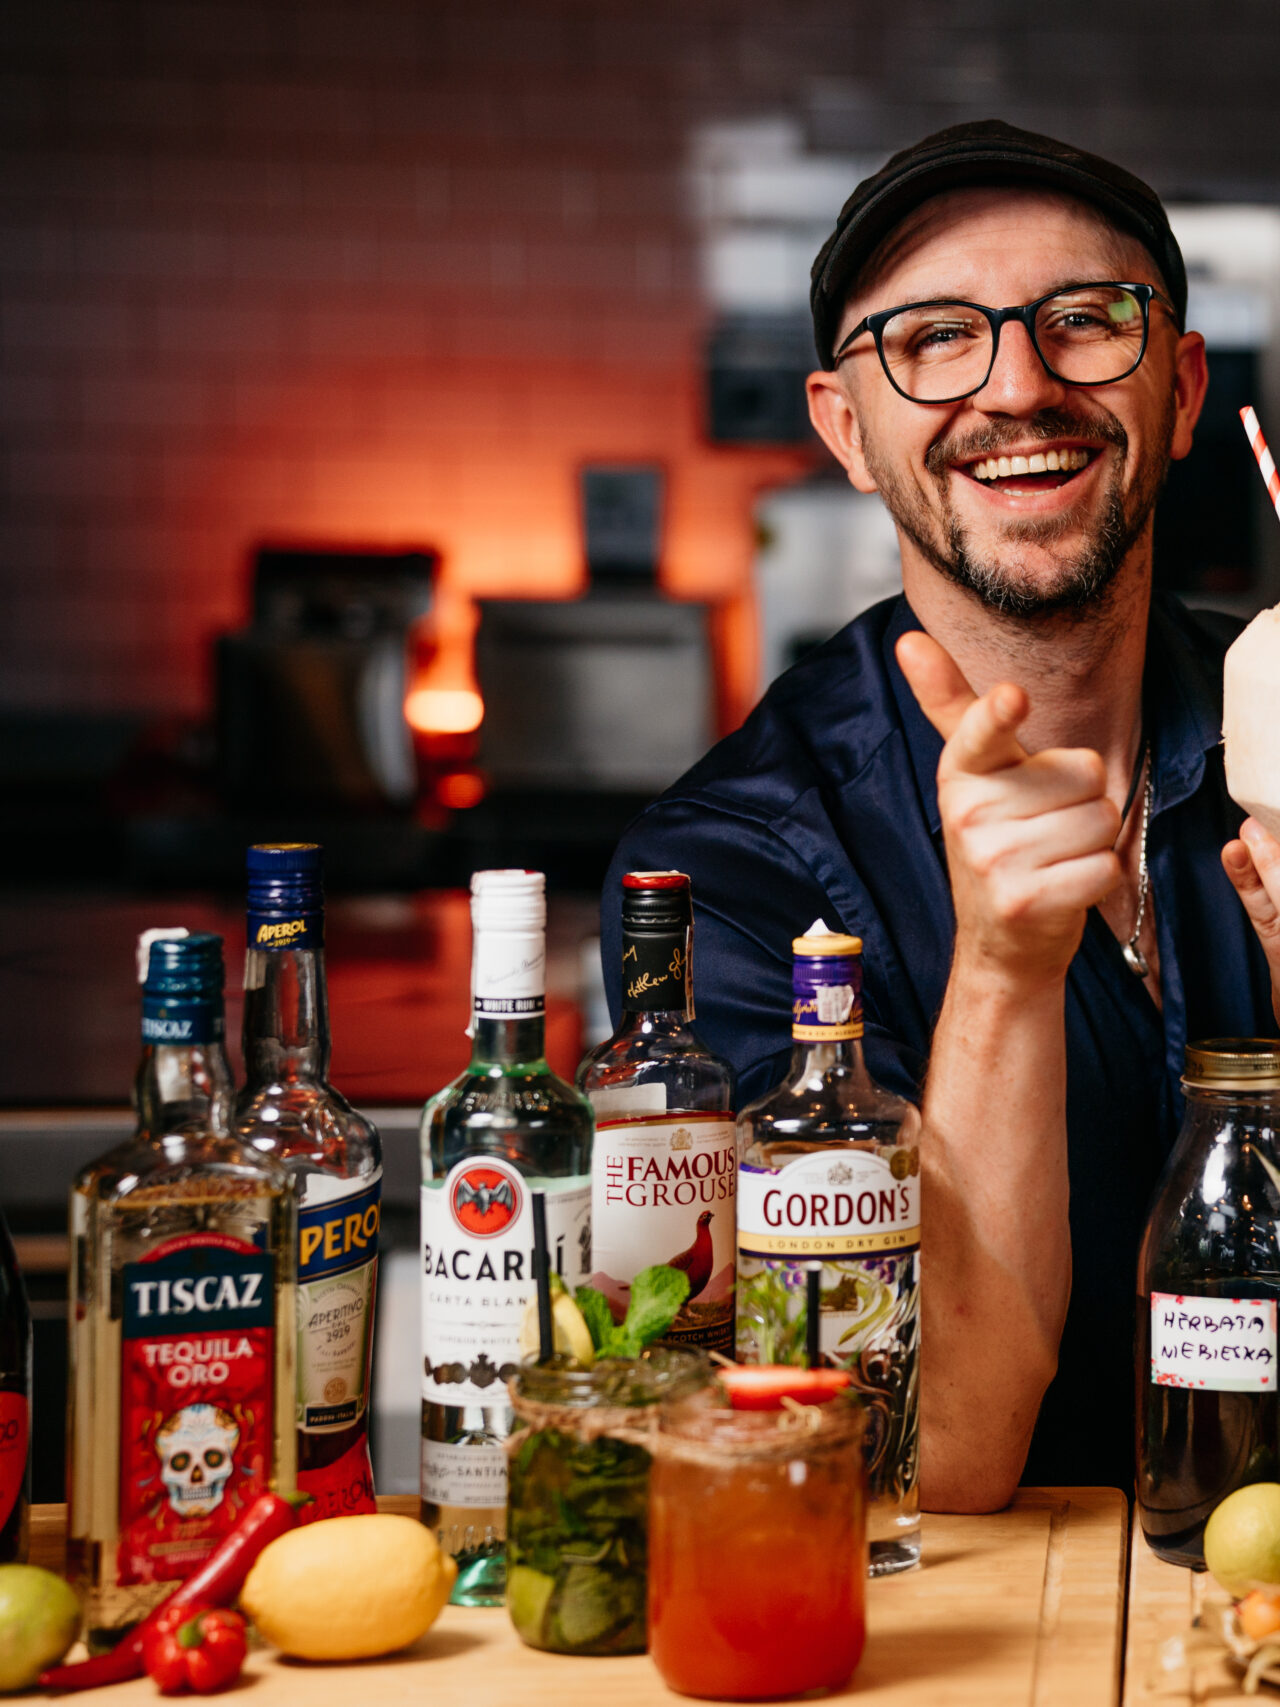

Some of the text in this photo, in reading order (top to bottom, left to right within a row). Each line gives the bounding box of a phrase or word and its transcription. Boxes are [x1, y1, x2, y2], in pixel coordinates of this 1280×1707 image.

[256, 919, 308, 943] APEROL
[482, 999, 535, 1012] WHITE RUM
[626, 1146, 735, 1181] FAMOUS
[606, 1155, 623, 1206] THE
[625, 1173, 734, 1207] GROUSE
[763, 1183, 910, 1227] GORDON'S
[300, 1204, 379, 1267] PERO
[768, 1235, 906, 1249] LONDON DRY GIN
[130, 1272, 264, 1318] TISCAZ
[481, 1296, 528, 1307] BLAN
[308, 1297, 364, 1328] APERITIVO
[1163, 1311, 1265, 1334] HERBATA
[142, 1337, 254, 1368] TEQUILA
[1161, 1341, 1274, 1365] NIEBIESKA
[167, 1361, 230, 1389] ORO
[456, 1465, 507, 1477] SANTIA
